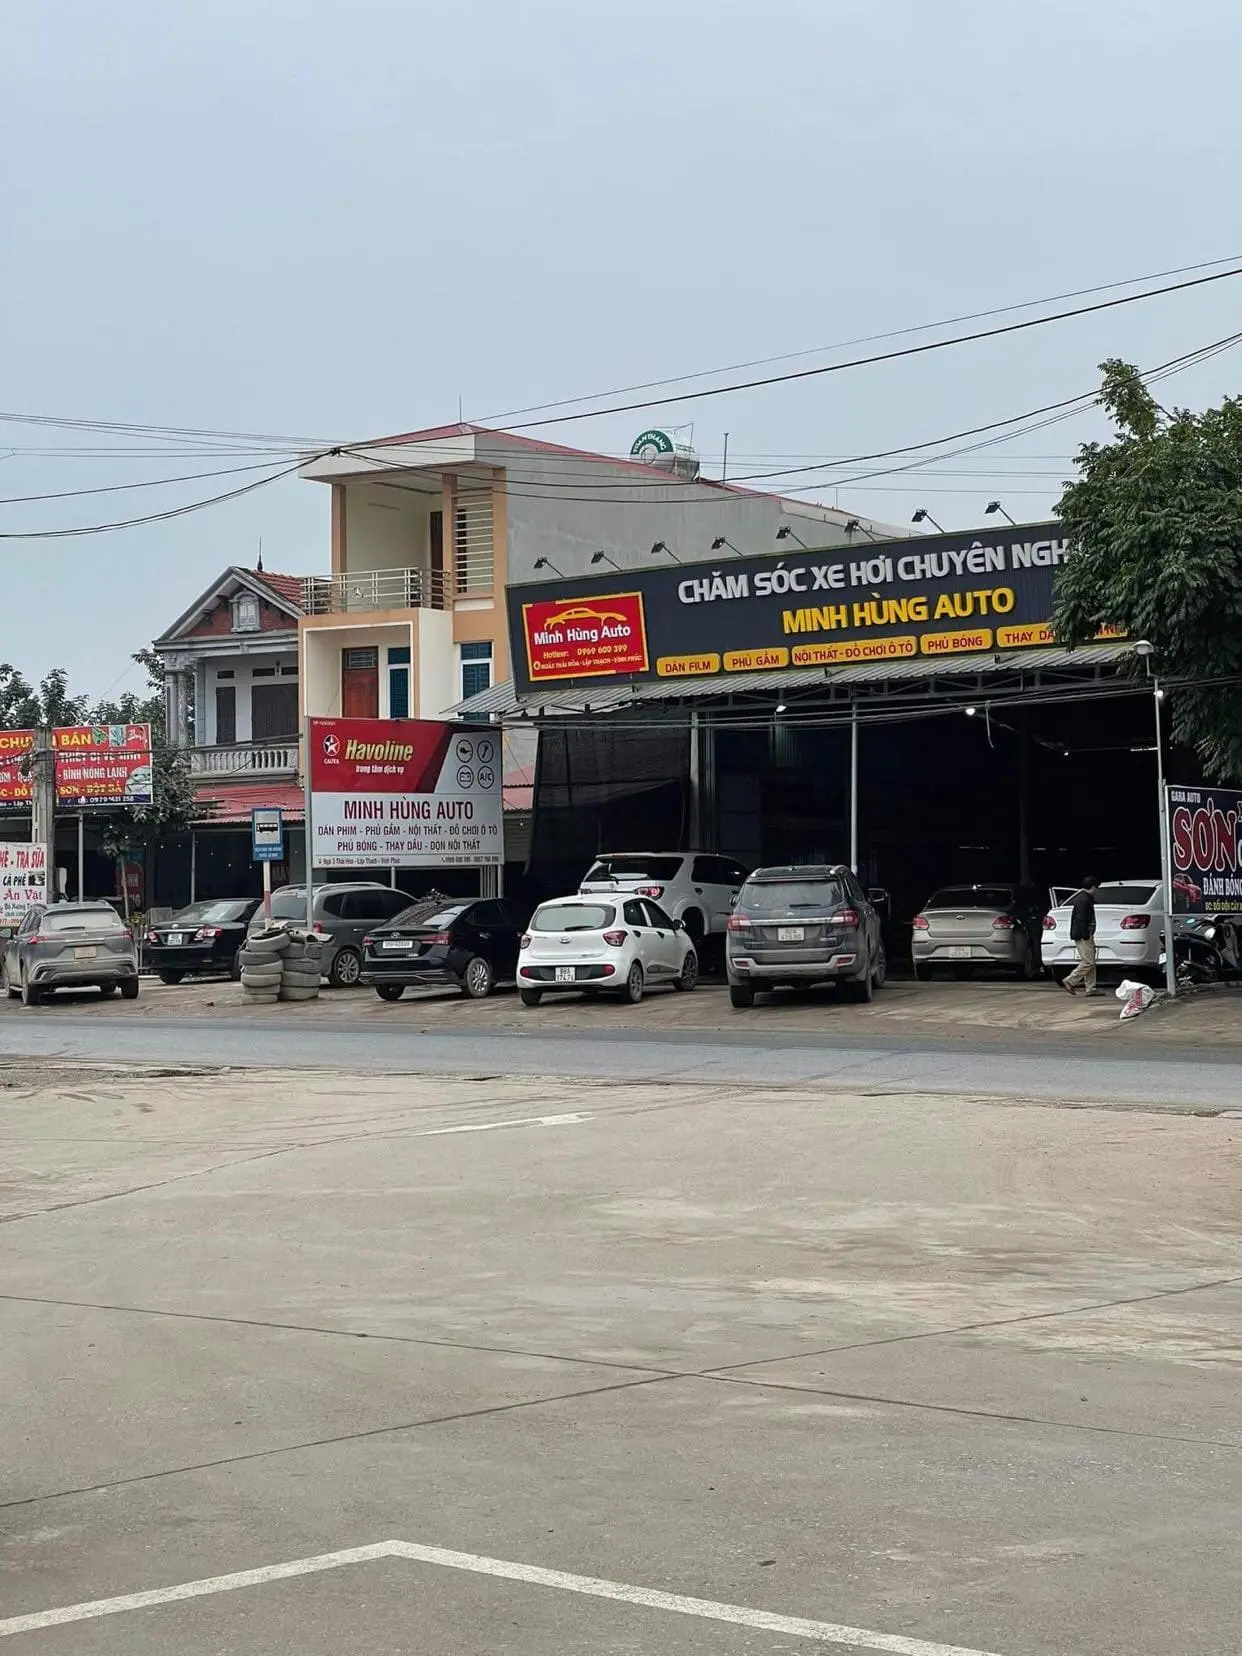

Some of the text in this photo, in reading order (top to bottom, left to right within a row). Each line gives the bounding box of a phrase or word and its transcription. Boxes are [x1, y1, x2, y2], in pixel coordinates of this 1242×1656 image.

[678, 539, 1070, 604] CHĂM SÓC XE HƠI CHUYÊN NGH
[782, 587, 1016, 634] MINH HÙNG AUTO
[534, 624, 631, 645] Minh Hùng Auto
[952, 634, 983, 648] BÓNG
[1005, 631, 1034, 644] THAY
[577, 647, 596, 656] 0969
[613, 644, 628, 653] 399
[794, 649, 812, 663] NỘI
[813, 645, 838, 660] THẤT
[863, 643, 886, 657] CHƠI
[888, 641, 896, 654] Ô
[898, 640, 913, 653] TÔ
[665, 660, 711, 673] DÁN FILM
[62, 731, 91, 746] BÁN
[345, 739, 414, 761] Havoline
[63, 765, 128, 781] BÌNH NÓNG LẠNH
[355, 764, 371, 774] trung
[371, 764, 383, 773] tâm
[384, 764, 396, 775] dịch
[344, 796, 474, 819] MINH HÙNG AUTO
[318, 824, 334, 835] DÁN
[337, 826, 357, 835] PHIM
[424, 824, 442, 835] THẤT
[1172, 797, 1237, 873] SƠN
[356, 839, 377, 851] BÓNG
[385, 841, 405, 851] THAY
[1203, 872, 1224, 896] ĐÁNH
